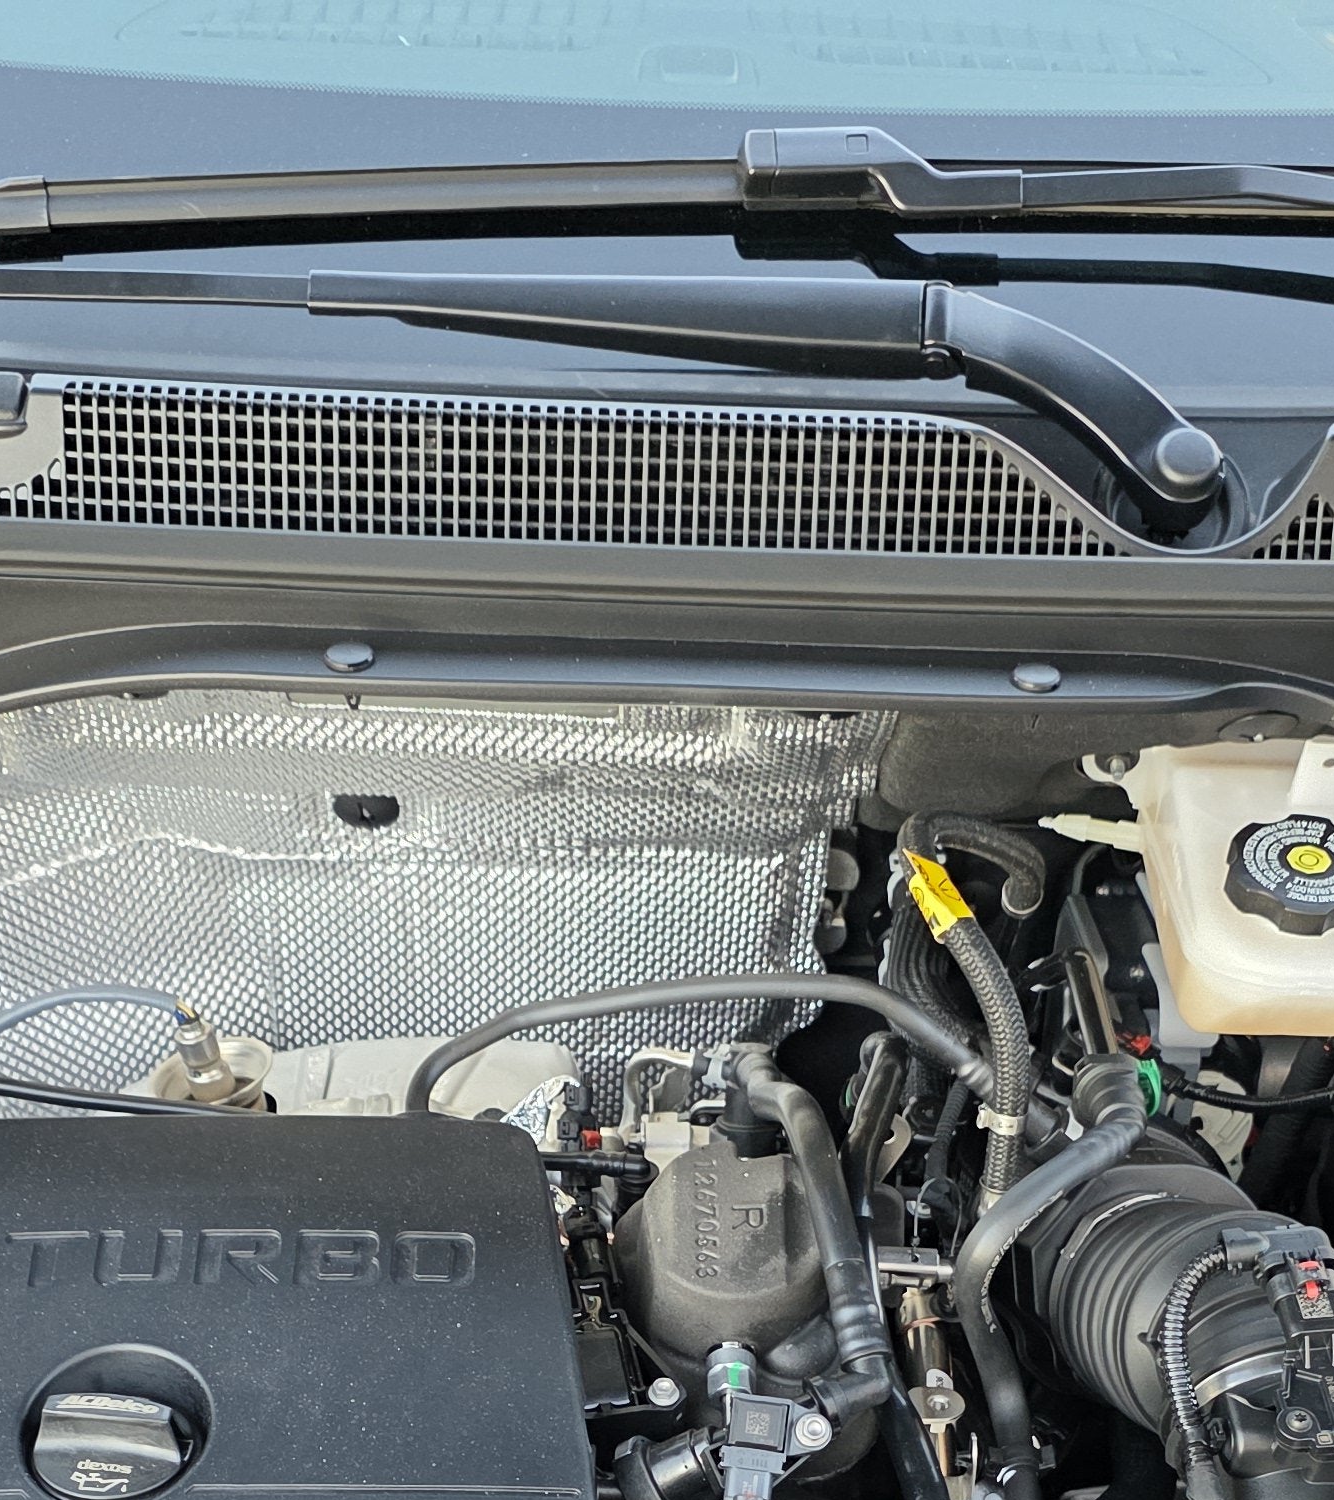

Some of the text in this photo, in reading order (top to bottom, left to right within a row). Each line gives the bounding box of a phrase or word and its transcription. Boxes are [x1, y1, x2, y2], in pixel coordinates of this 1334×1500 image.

[731, 1203, 768, 1230] R
[5, 1228, 476, 1287] TURBO
[58, 1395, 160, 1414] ACDelco
[77, 1459, 133, 1474] dexos
